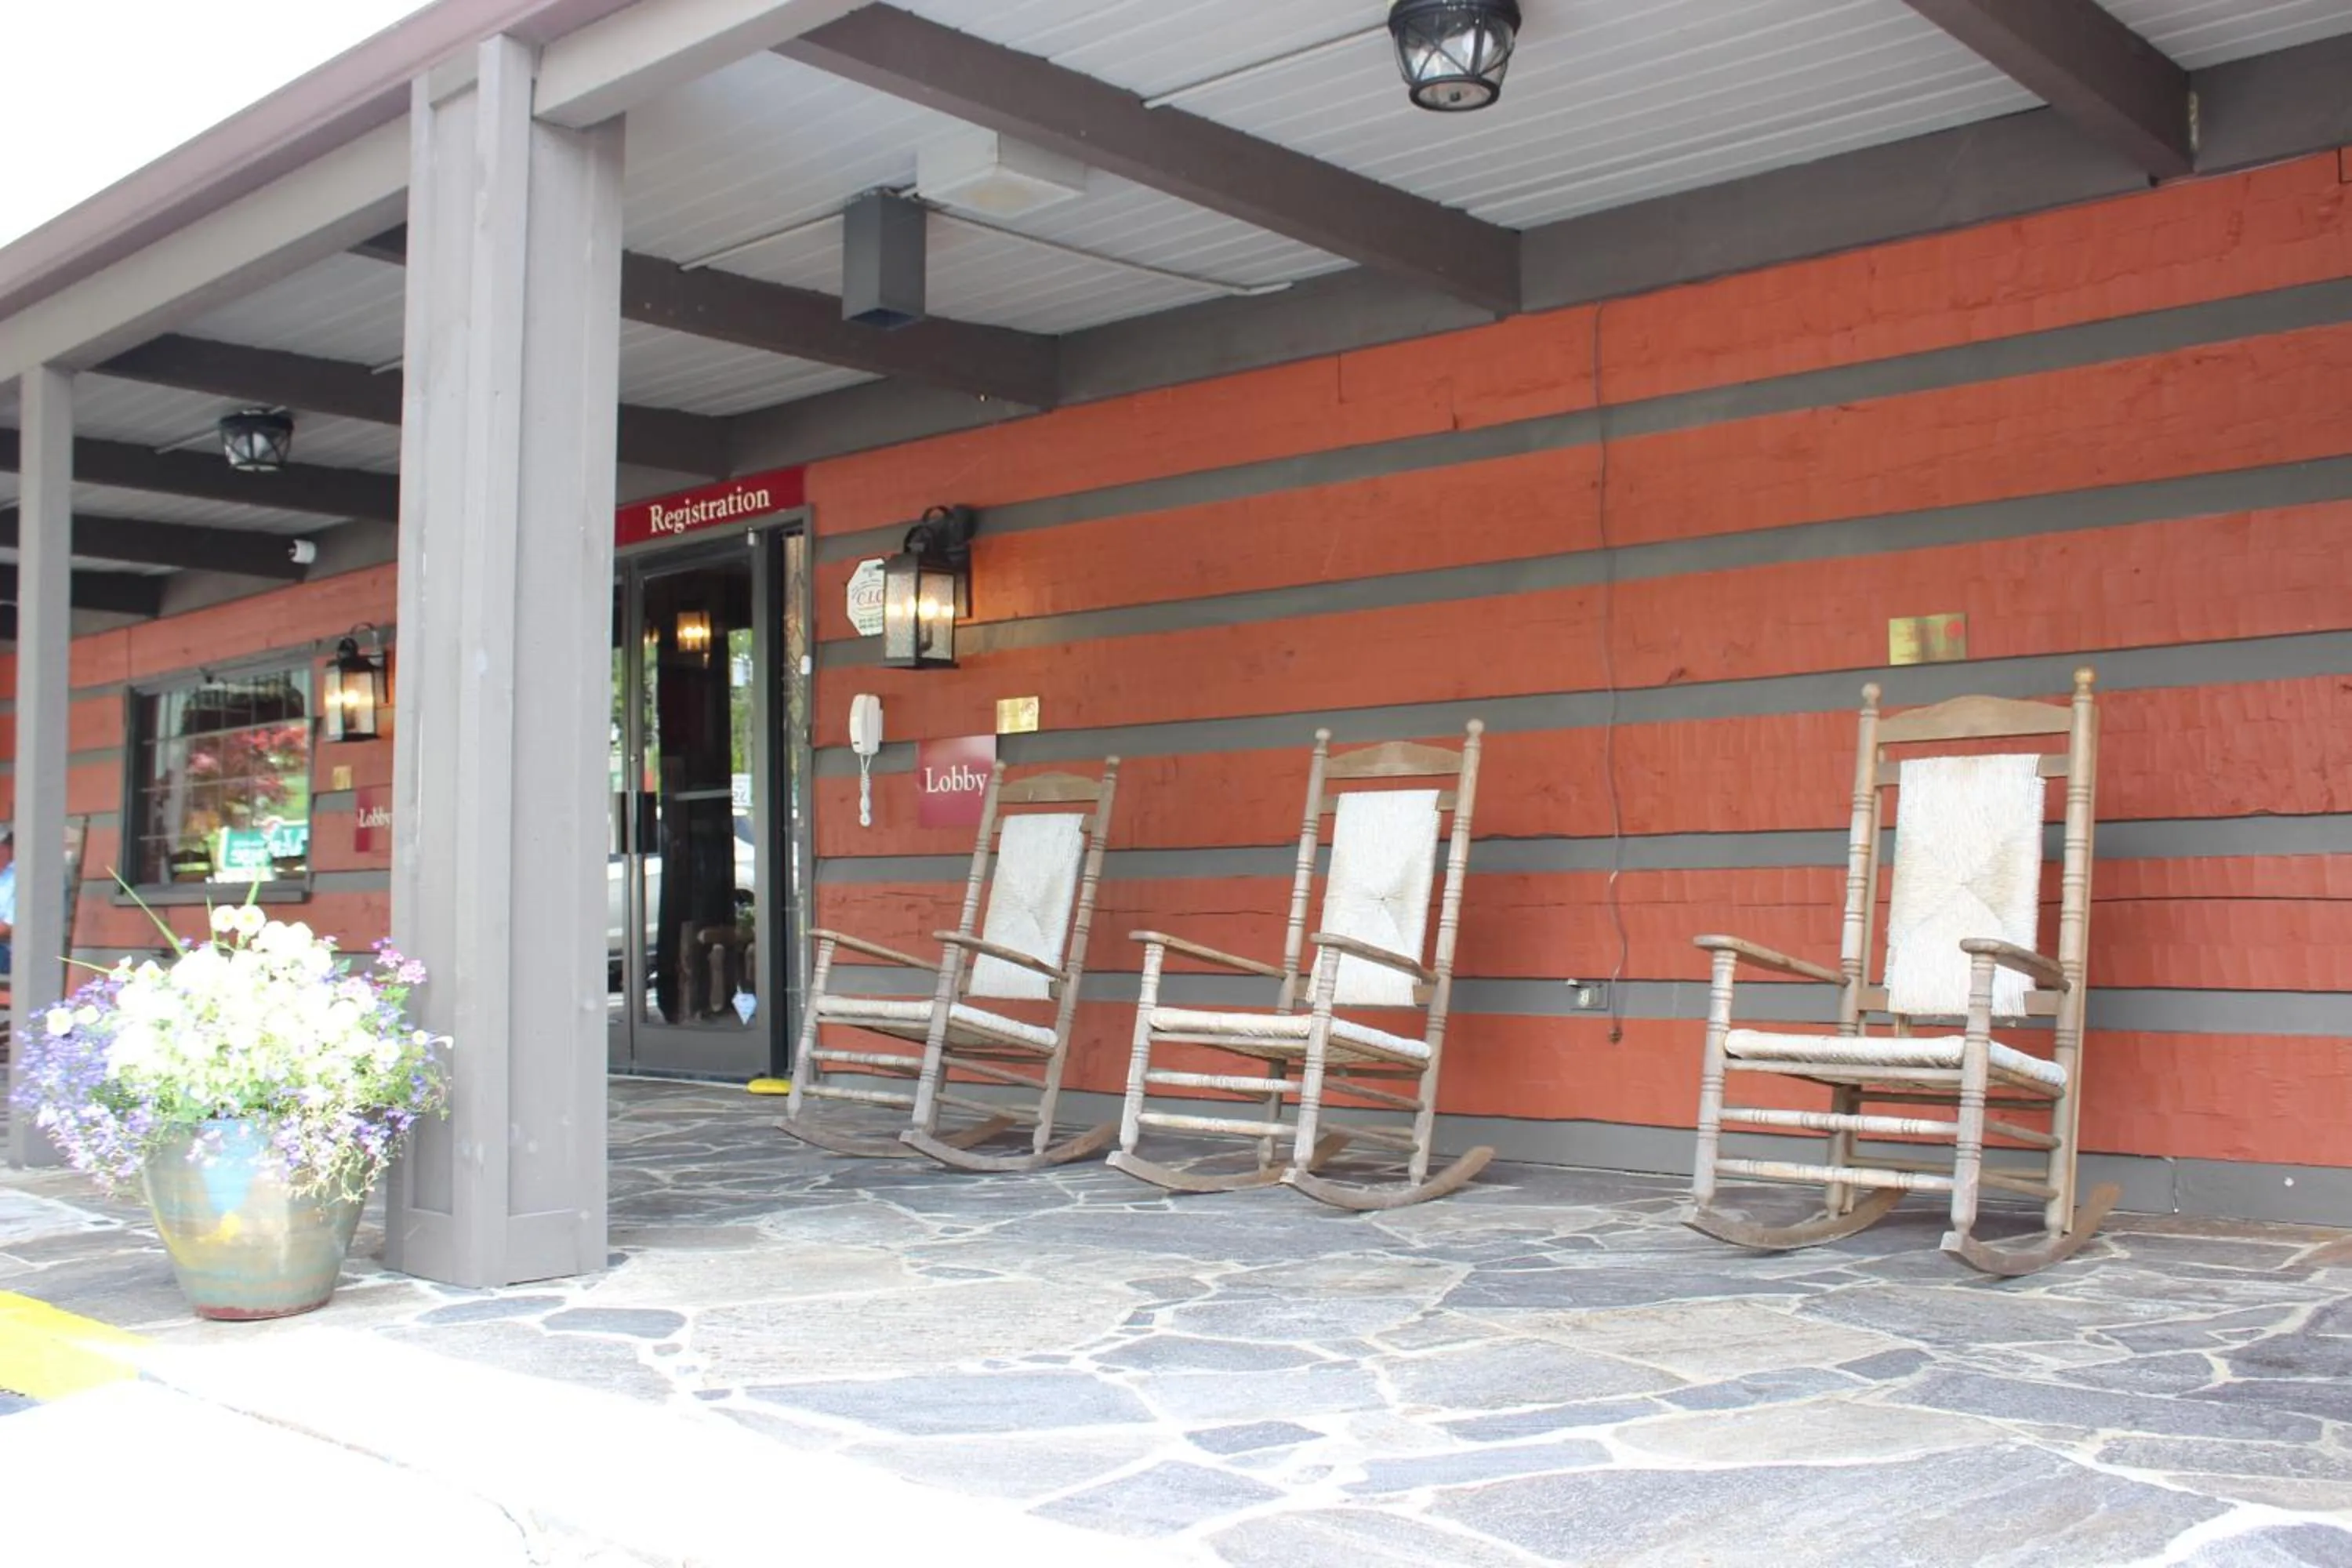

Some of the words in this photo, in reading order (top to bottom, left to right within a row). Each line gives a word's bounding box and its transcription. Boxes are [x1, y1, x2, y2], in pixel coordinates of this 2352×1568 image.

[649, 486, 771, 534] Registration
[924, 764, 987, 797] Lobby
[358, 805, 392, 829] Lobby
